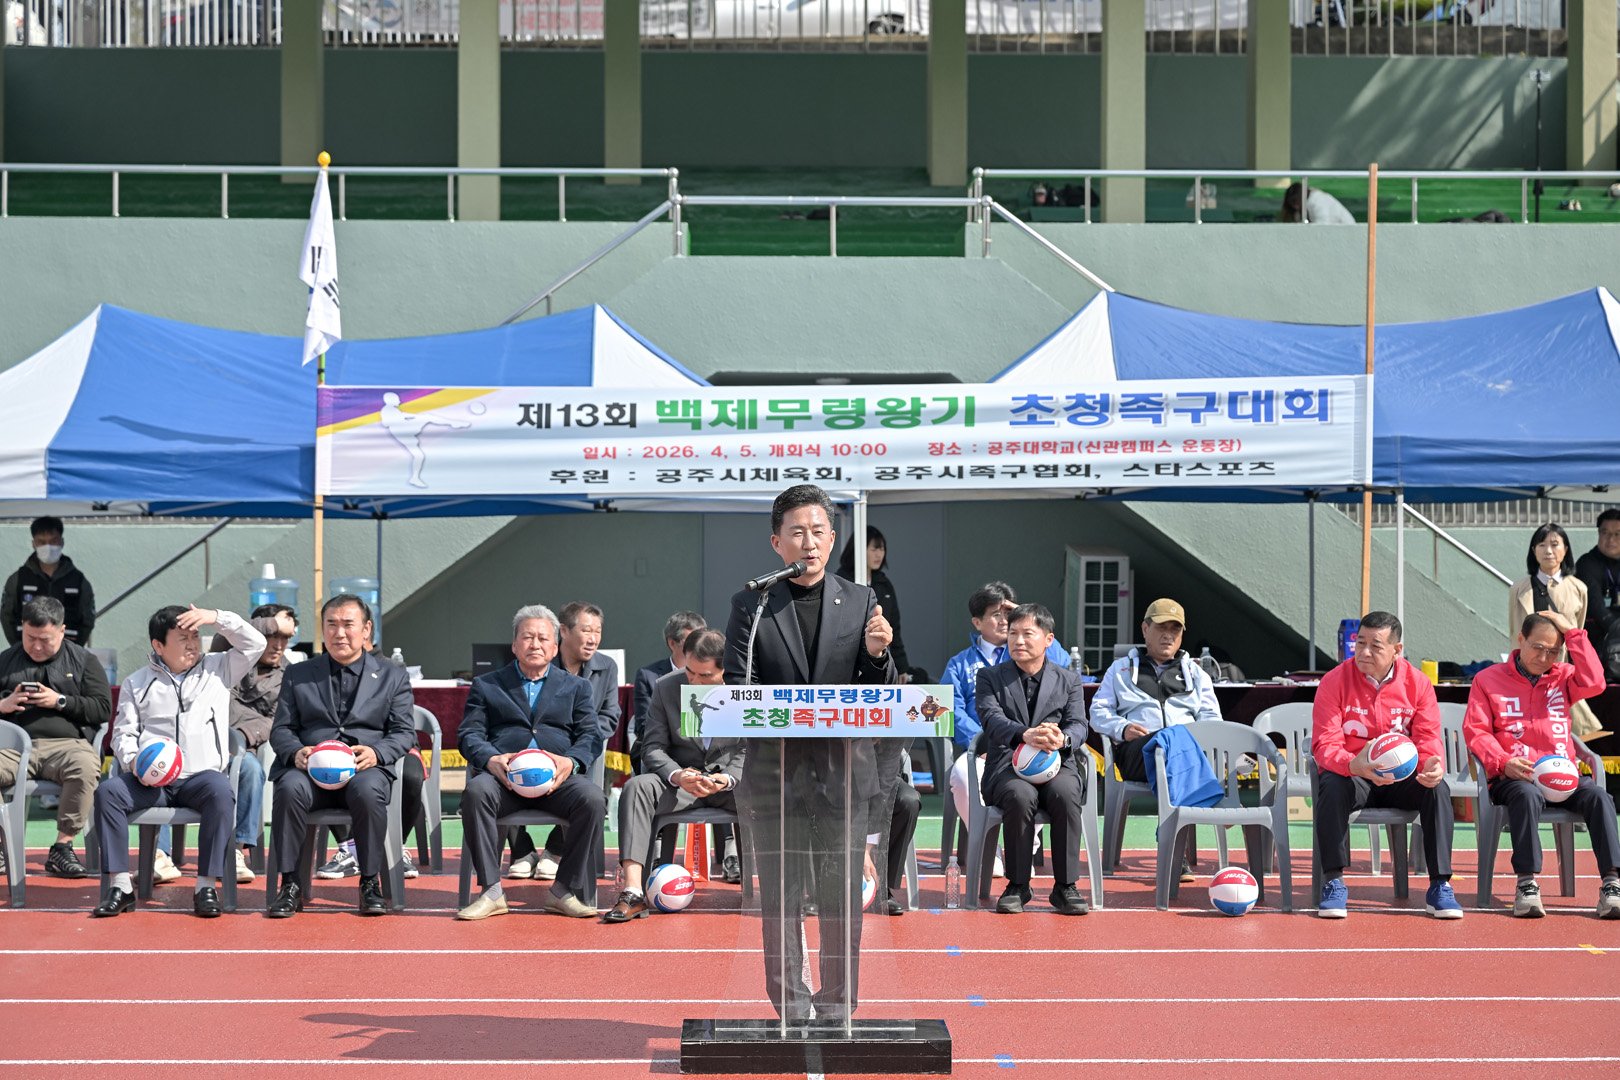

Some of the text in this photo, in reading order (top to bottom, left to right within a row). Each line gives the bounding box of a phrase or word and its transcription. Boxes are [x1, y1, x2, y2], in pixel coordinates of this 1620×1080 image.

[517, 389, 1330, 430] 제13회 백제무령왕기 초청족구대회
[583, 446, 617, 460] 일시
[643, 446, 699, 459] 2026.
[740, 444, 756, 458] 5.
[769, 443, 821, 458] 개회식
[831, 443, 887, 456] 10:00
[928, 441, 962, 456] 장소
[988, 440, 1172, 455] 공주대학교(신관캠퍼스
[1182, 438, 1242, 453] 운동장)
[549, 469, 609, 484] 후원
[656, 467, 852, 484] 공주시체육회,
[874, 464, 1101, 481] 공주시족구협회,
[1122, 461, 1276, 477] 스타스포츠
[730, 688, 902, 704] 제13회 백제무령왕기
[742, 707, 892, 729] 초청족구대회
